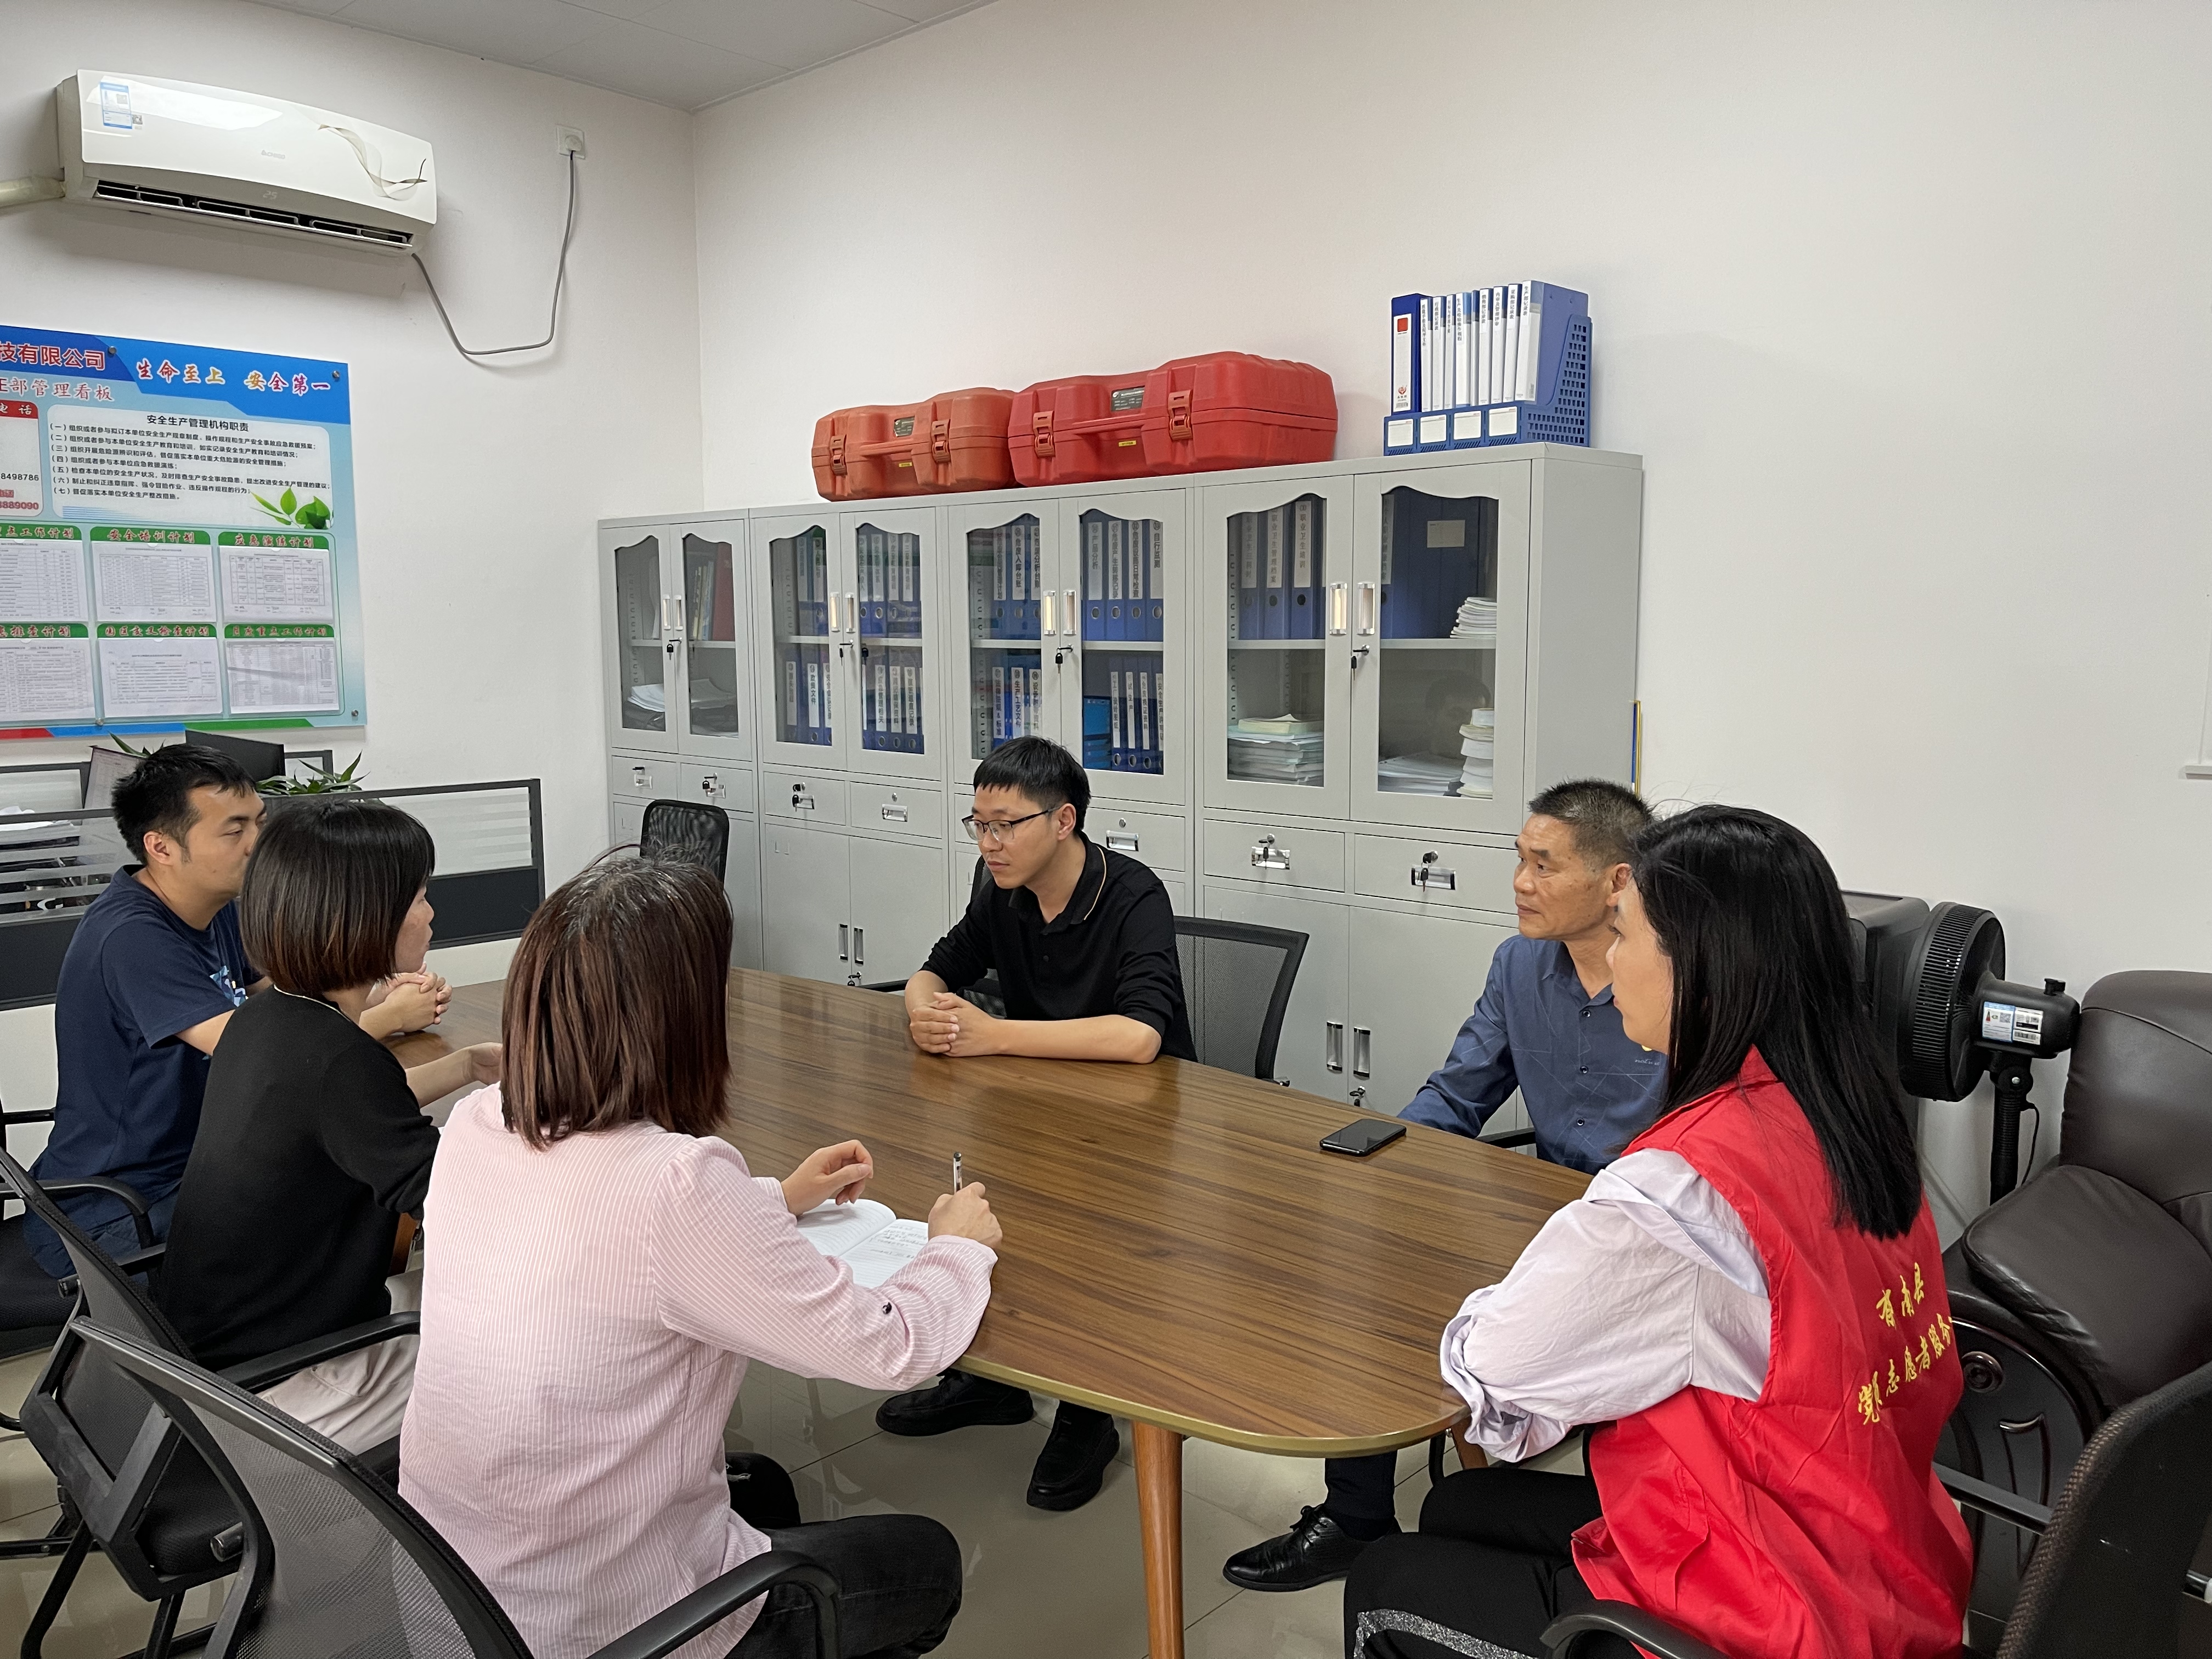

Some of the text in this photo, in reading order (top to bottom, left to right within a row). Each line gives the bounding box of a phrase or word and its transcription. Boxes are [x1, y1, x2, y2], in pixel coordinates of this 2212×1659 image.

[137, 358, 330, 396] 生命至上 安全第一
[146, 415, 249, 432] 安全生产管理机构职责
[0, 525, 74, 539] 点工作计划
[106, 528, 196, 544] 安全培训计划
